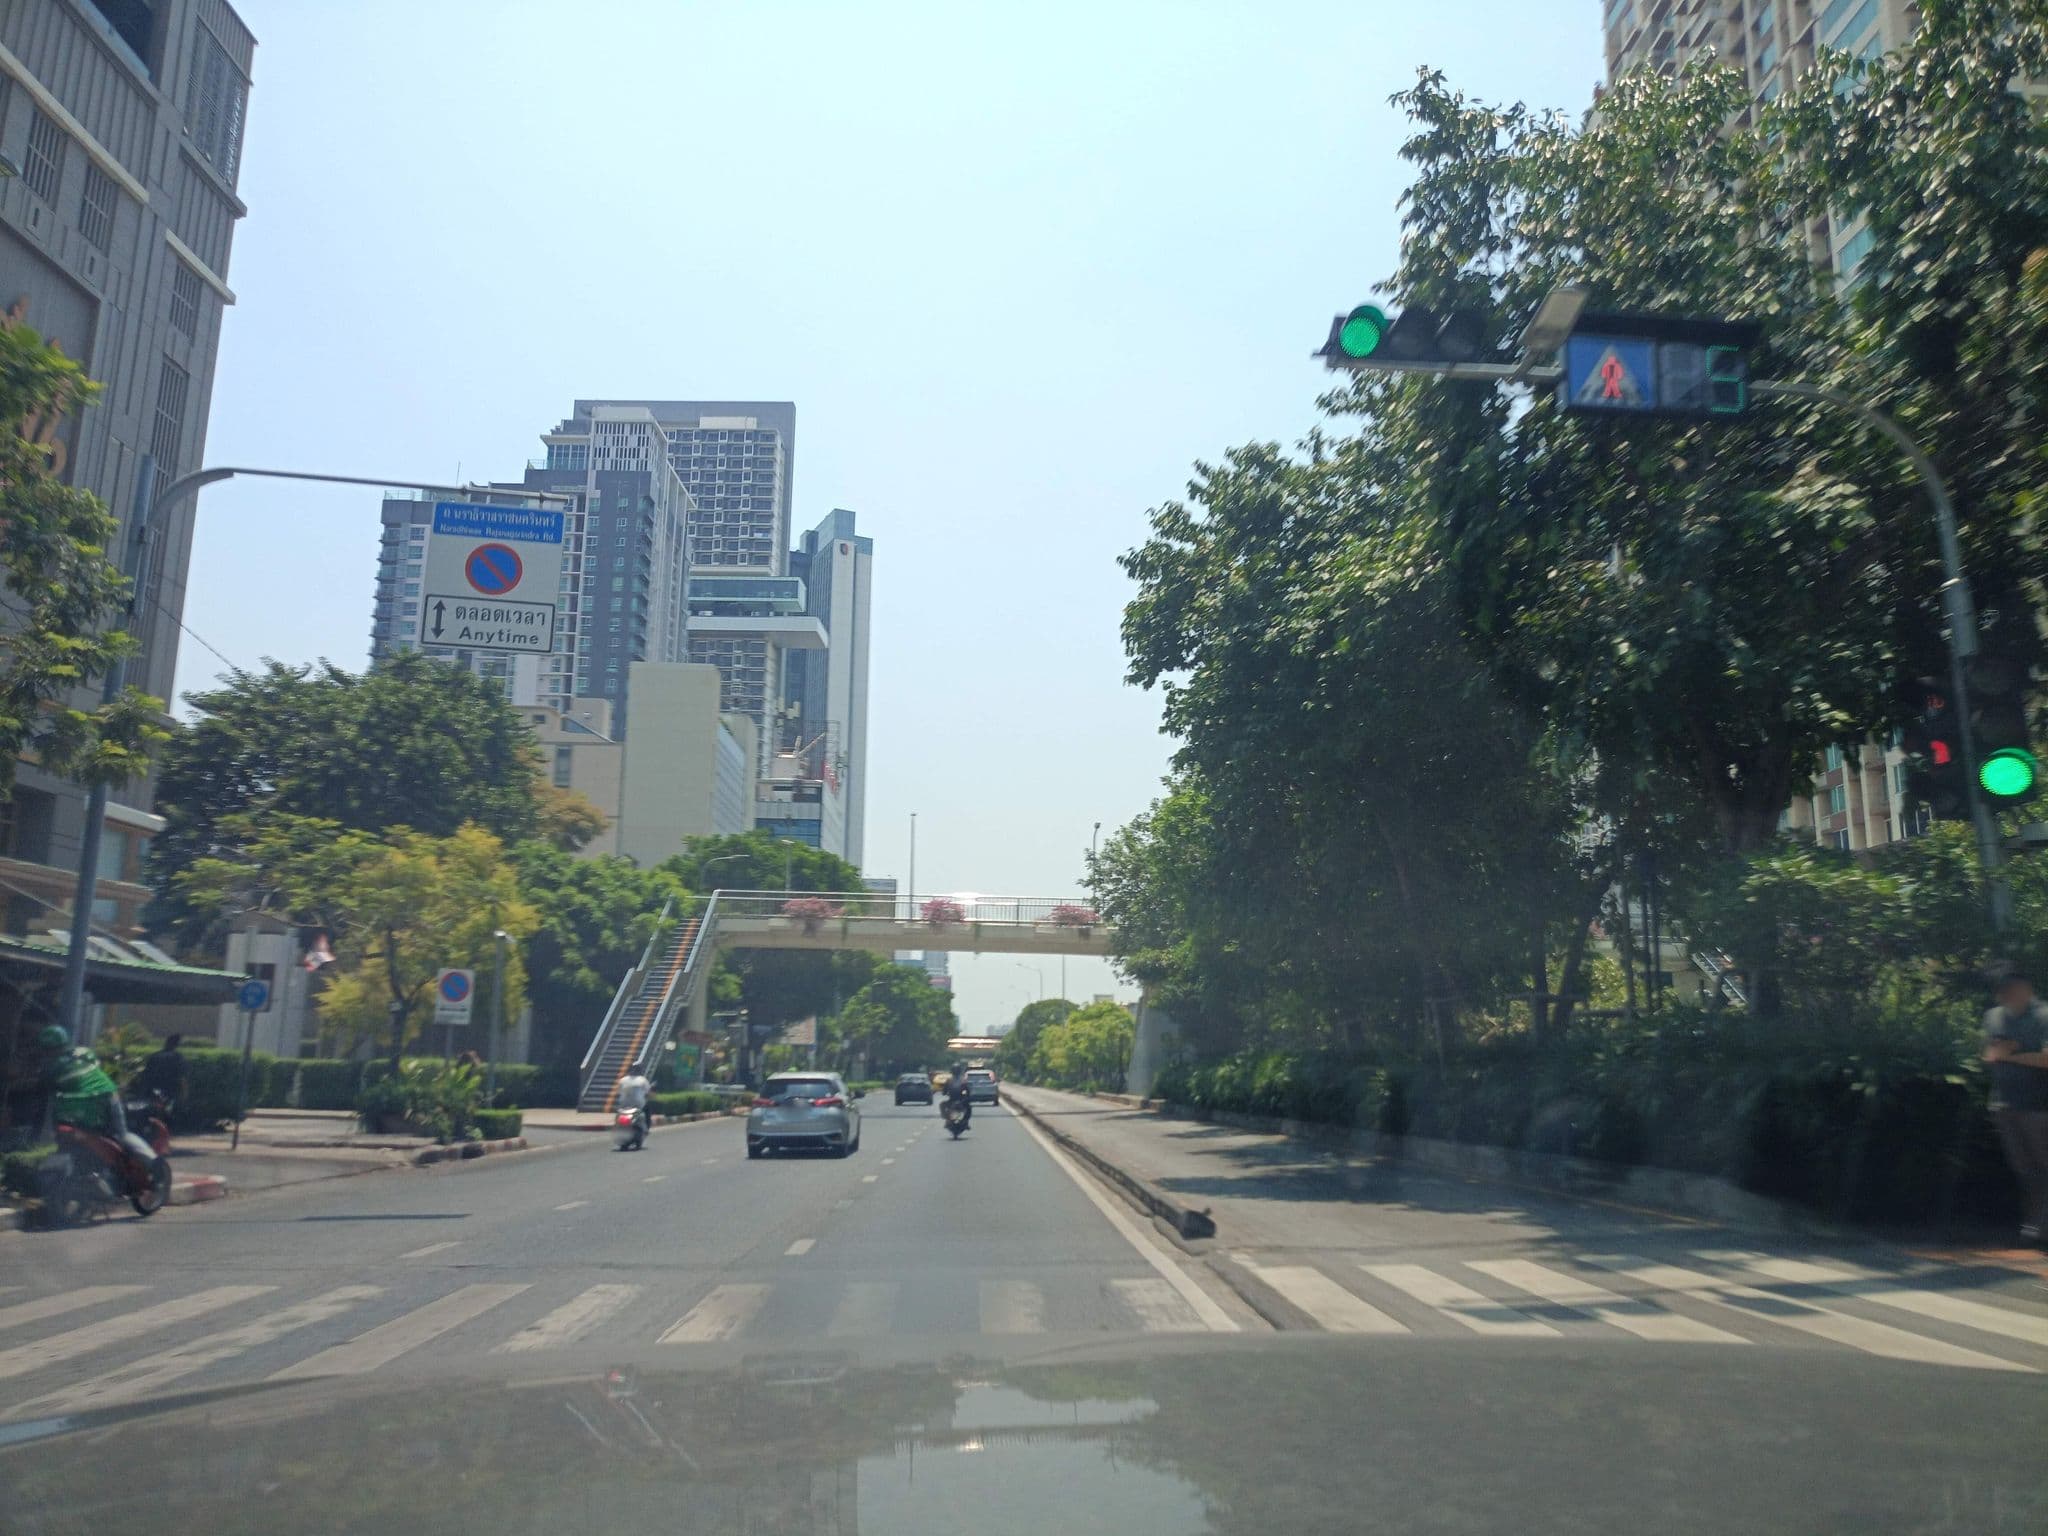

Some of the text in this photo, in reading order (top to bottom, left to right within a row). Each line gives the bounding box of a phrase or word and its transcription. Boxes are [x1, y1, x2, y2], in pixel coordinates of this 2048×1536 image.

[1705, 345, 1745, 413] 5
[455, 605, 546, 626] ตลอดเวลา
[458, 625, 540, 644] Anytime
